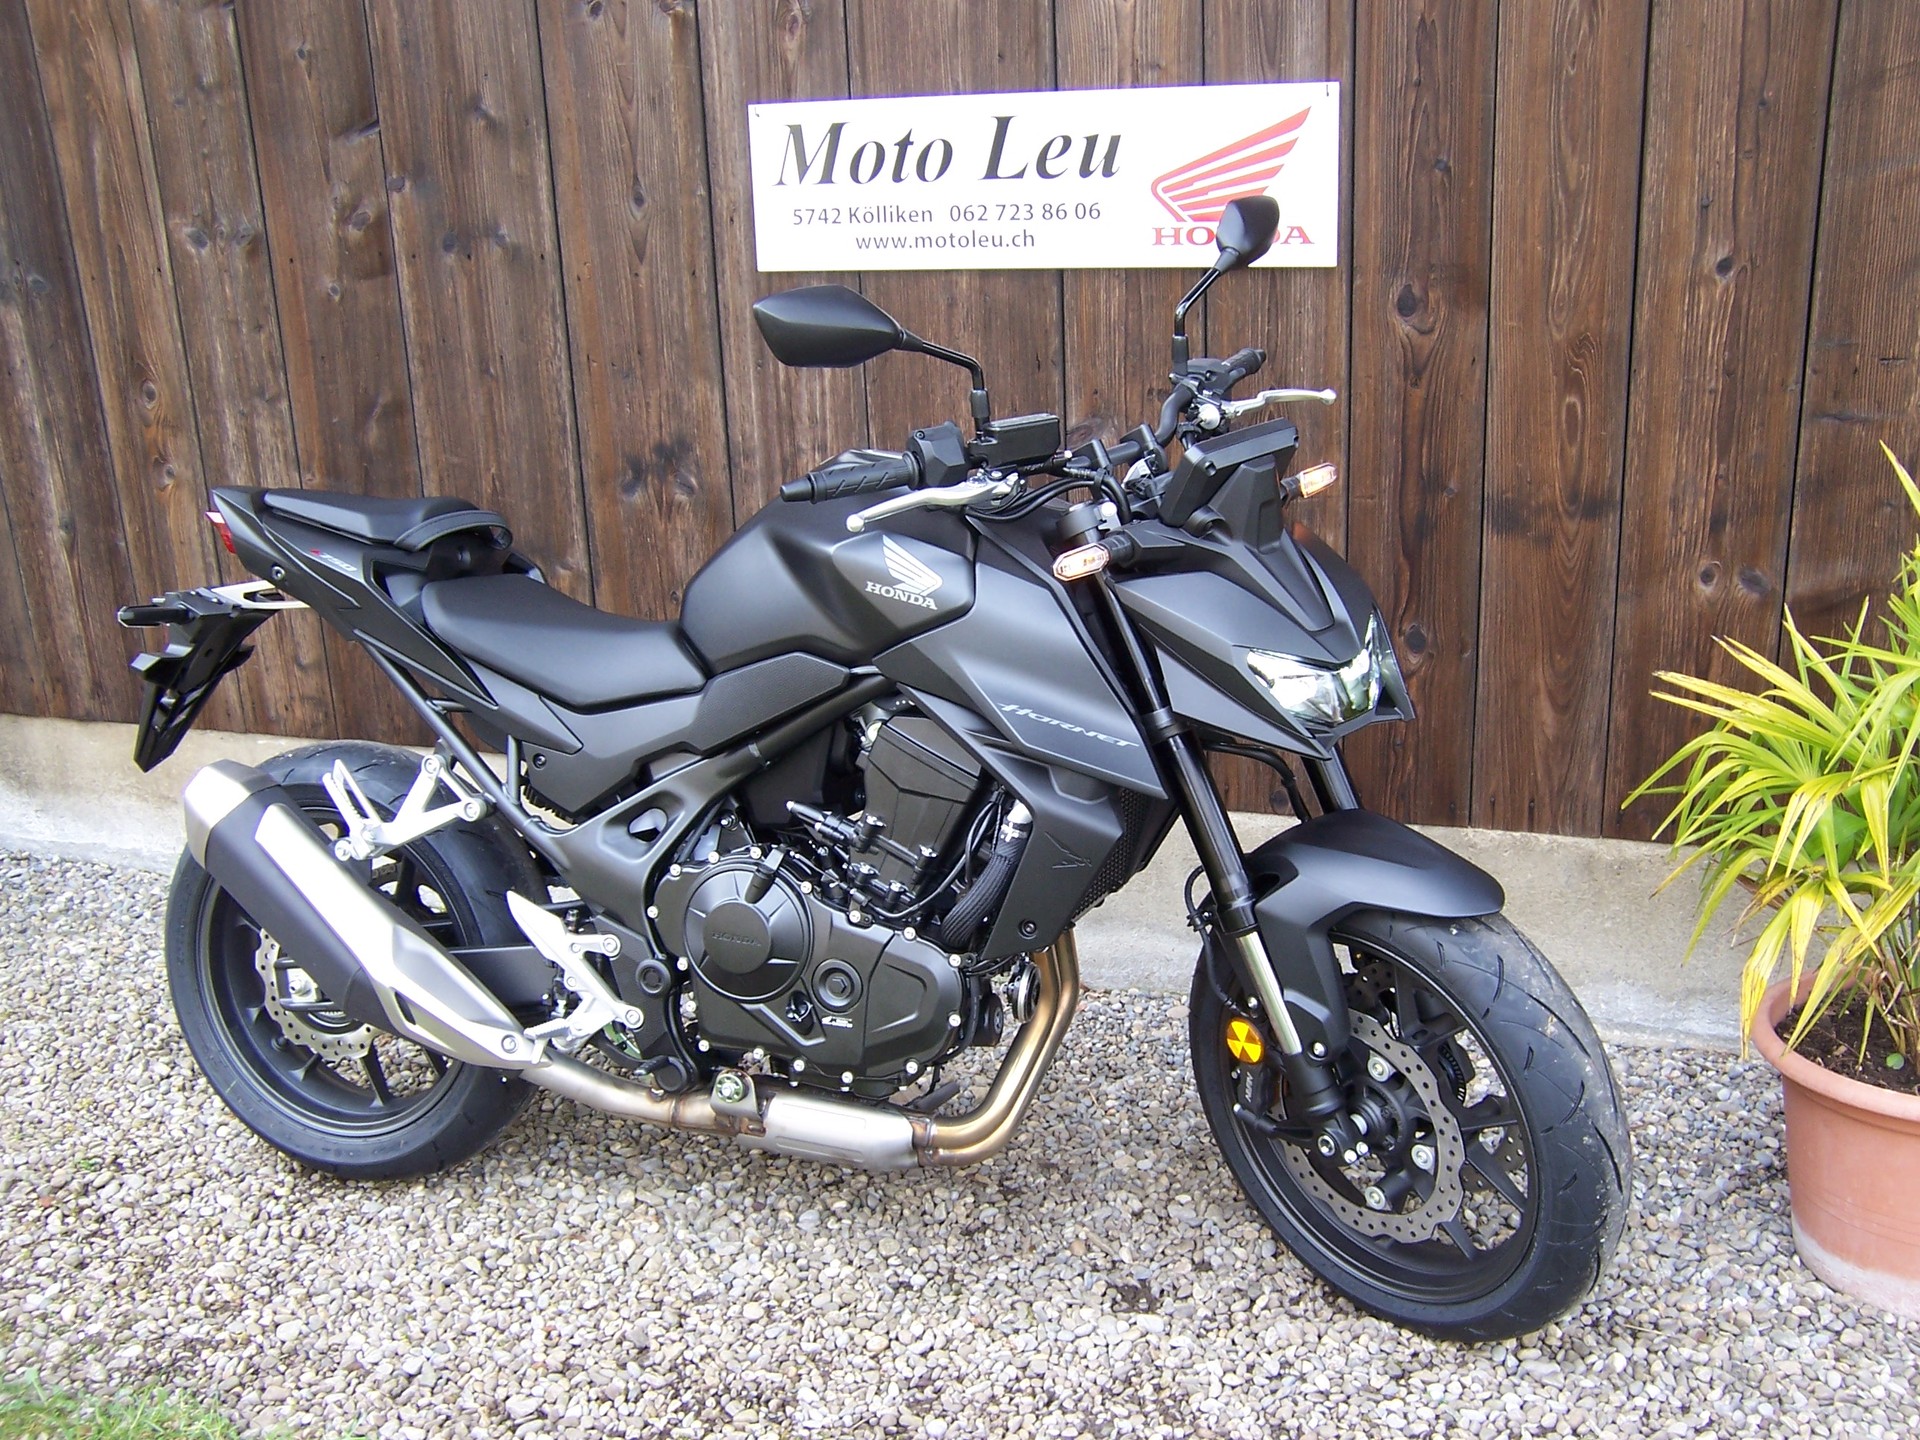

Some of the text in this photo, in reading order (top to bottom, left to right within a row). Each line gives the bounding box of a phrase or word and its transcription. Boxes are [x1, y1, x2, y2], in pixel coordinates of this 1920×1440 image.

[773, 115, 1122, 186] Moto Leu
[792, 201, 1101, 225] 5742 Kölliken 062 723 86 06
[855, 233, 1036, 250] www.motoleu.ch
[1152, 226, 1315, 246] HOA
[865, 581, 938, 610] HONDA
